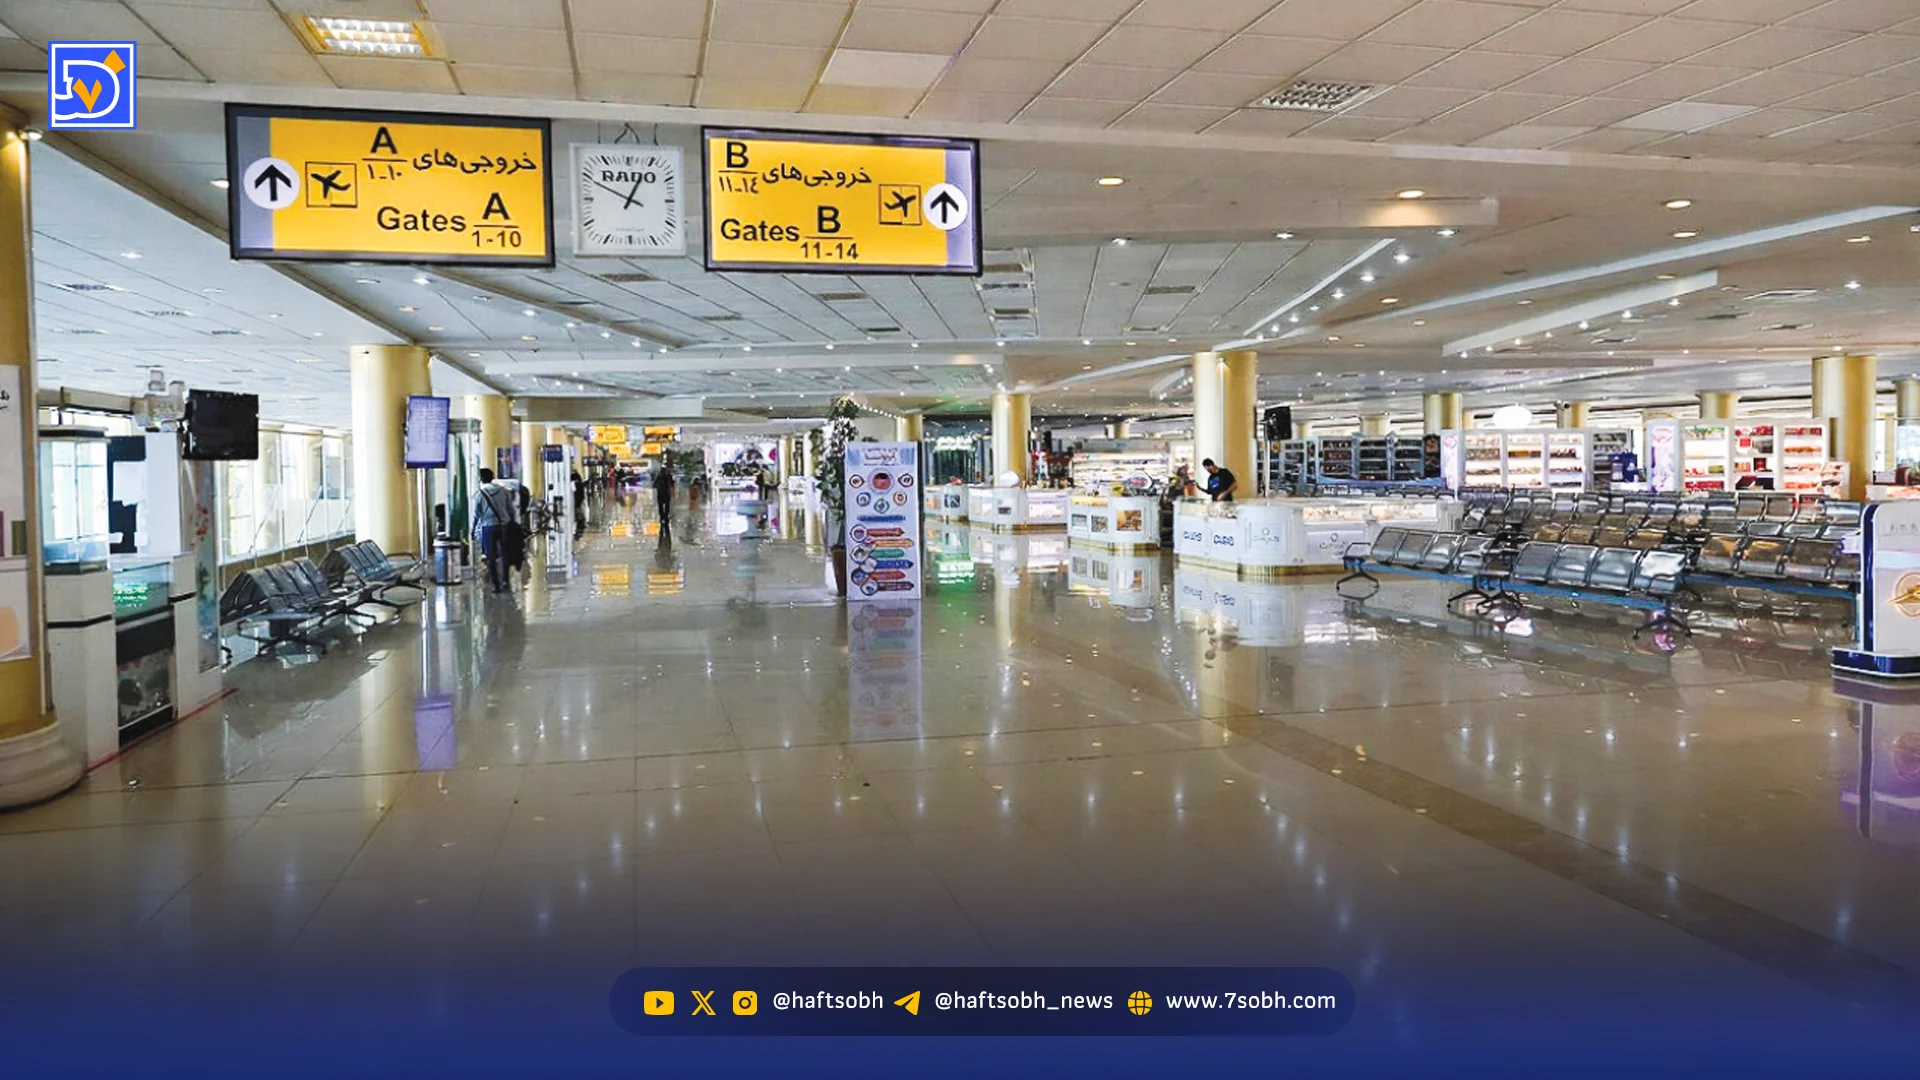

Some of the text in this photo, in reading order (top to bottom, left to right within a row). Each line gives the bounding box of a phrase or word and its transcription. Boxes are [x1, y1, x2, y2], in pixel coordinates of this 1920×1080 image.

[370, 126, 398, 154] A
[726, 141, 749, 168] B
[602, 170, 656, 183] RADO
[377, 192, 510, 232] Gates A
[720, 205, 841, 241] Gates B
[472, 230, 521, 247] 1-10
[800, 242, 858, 259] 11-14
